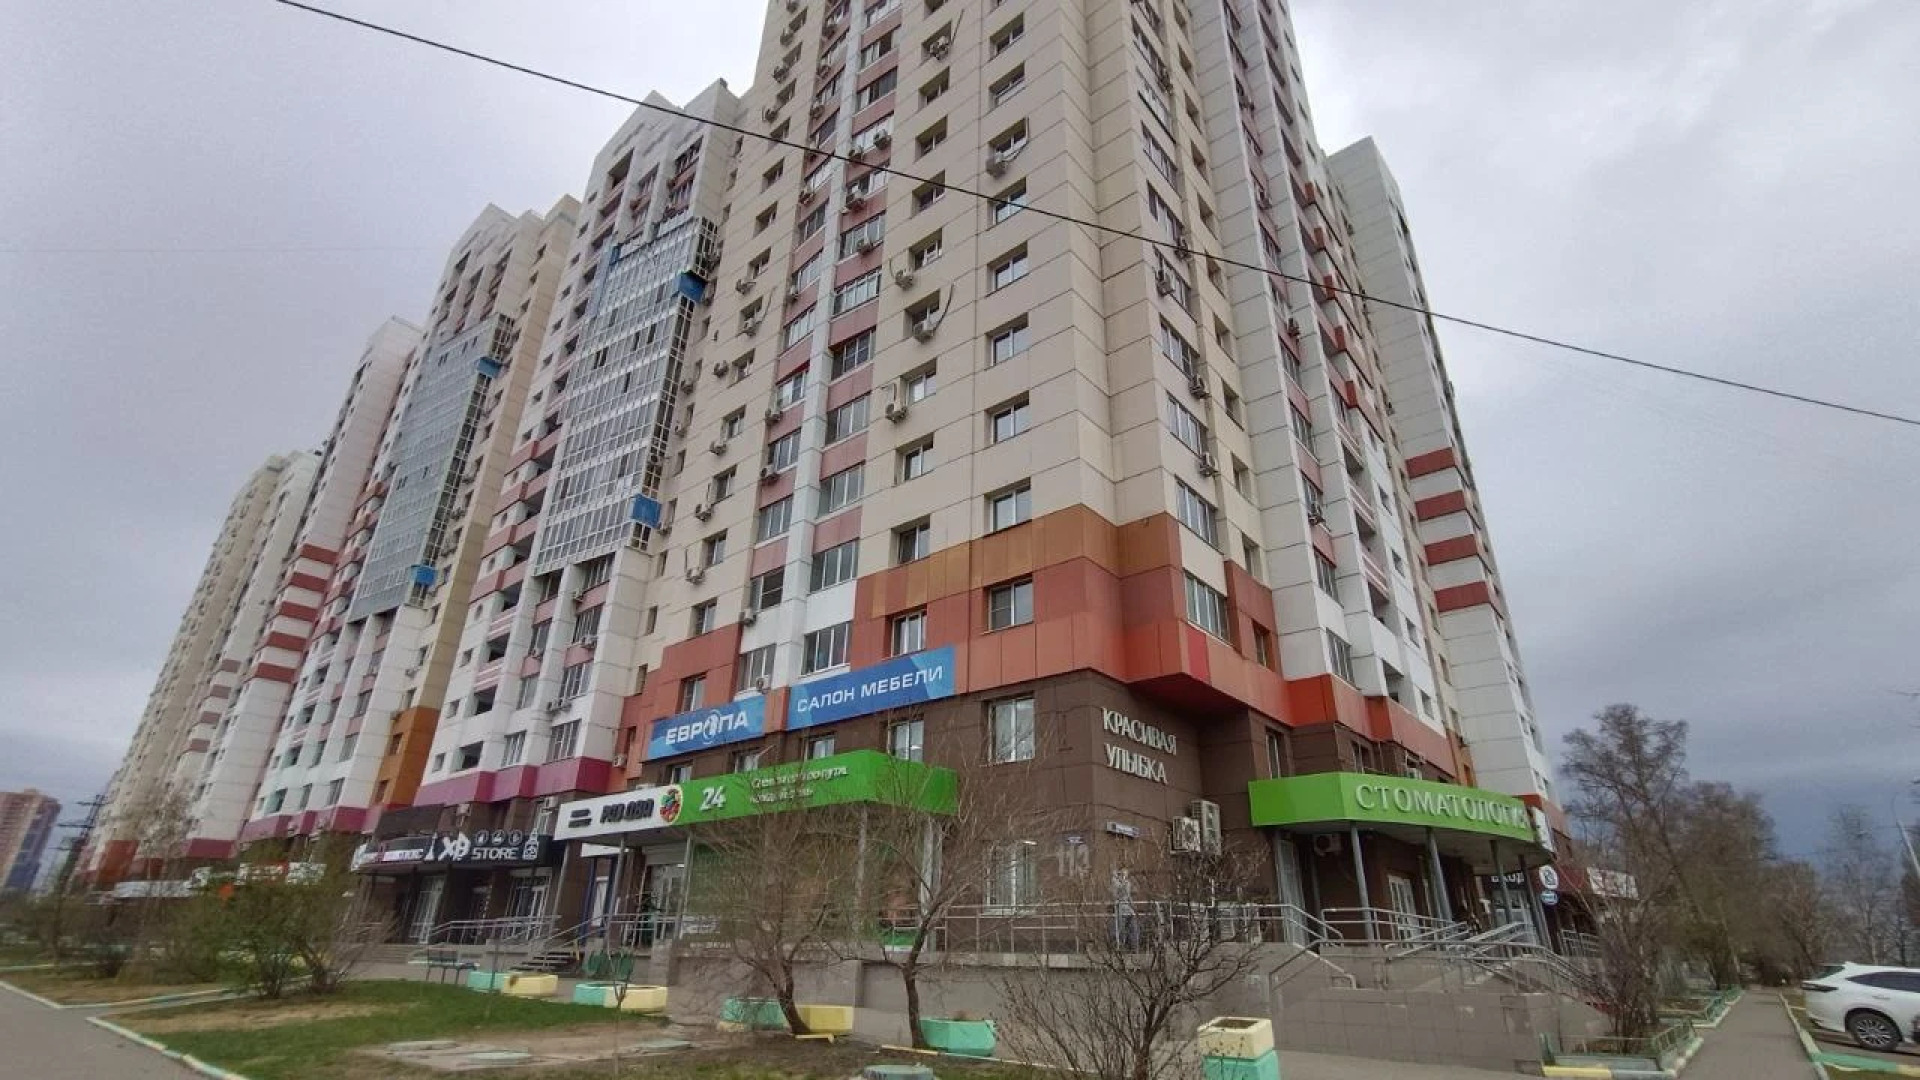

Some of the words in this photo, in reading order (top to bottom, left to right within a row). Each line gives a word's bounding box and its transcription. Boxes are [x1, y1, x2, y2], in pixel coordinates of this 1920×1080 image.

[796, 686, 855, 714] САЛОН
[860, 664, 944, 698] МЕБЕЛИ
[665, 708, 749, 746] ЕВРОПА
[1102, 707, 1177, 755] КРАСИВАЯ
[1104, 743, 1167, 784] УЛЫБКА
[698, 785, 727, 812] 24
[471, 845, 519, 861] STORE
